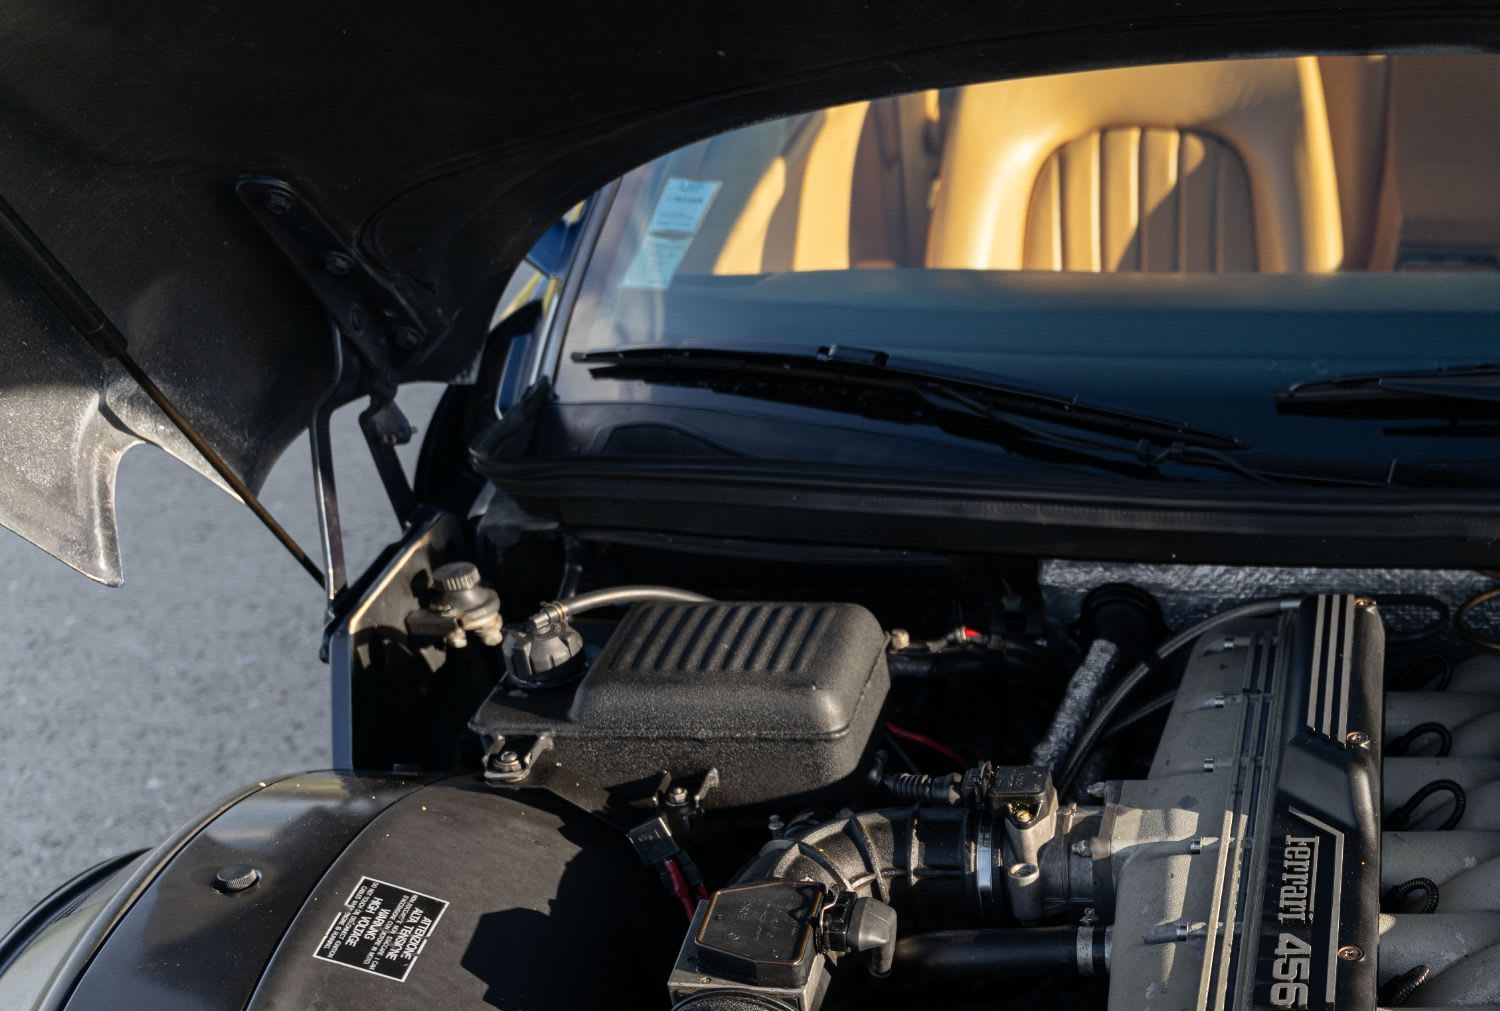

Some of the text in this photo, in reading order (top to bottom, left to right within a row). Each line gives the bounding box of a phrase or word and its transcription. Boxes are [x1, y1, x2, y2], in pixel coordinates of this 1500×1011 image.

[345, 897, 383, 947] HIGH VOLTAGE
[364, 909, 390, 940] WARNING
[386, 907, 423, 960] ALTA TENSIONE
[401, 917, 431, 959] ATTENZIONE
[1270, 834, 1320, 1010] Ferrari 456
